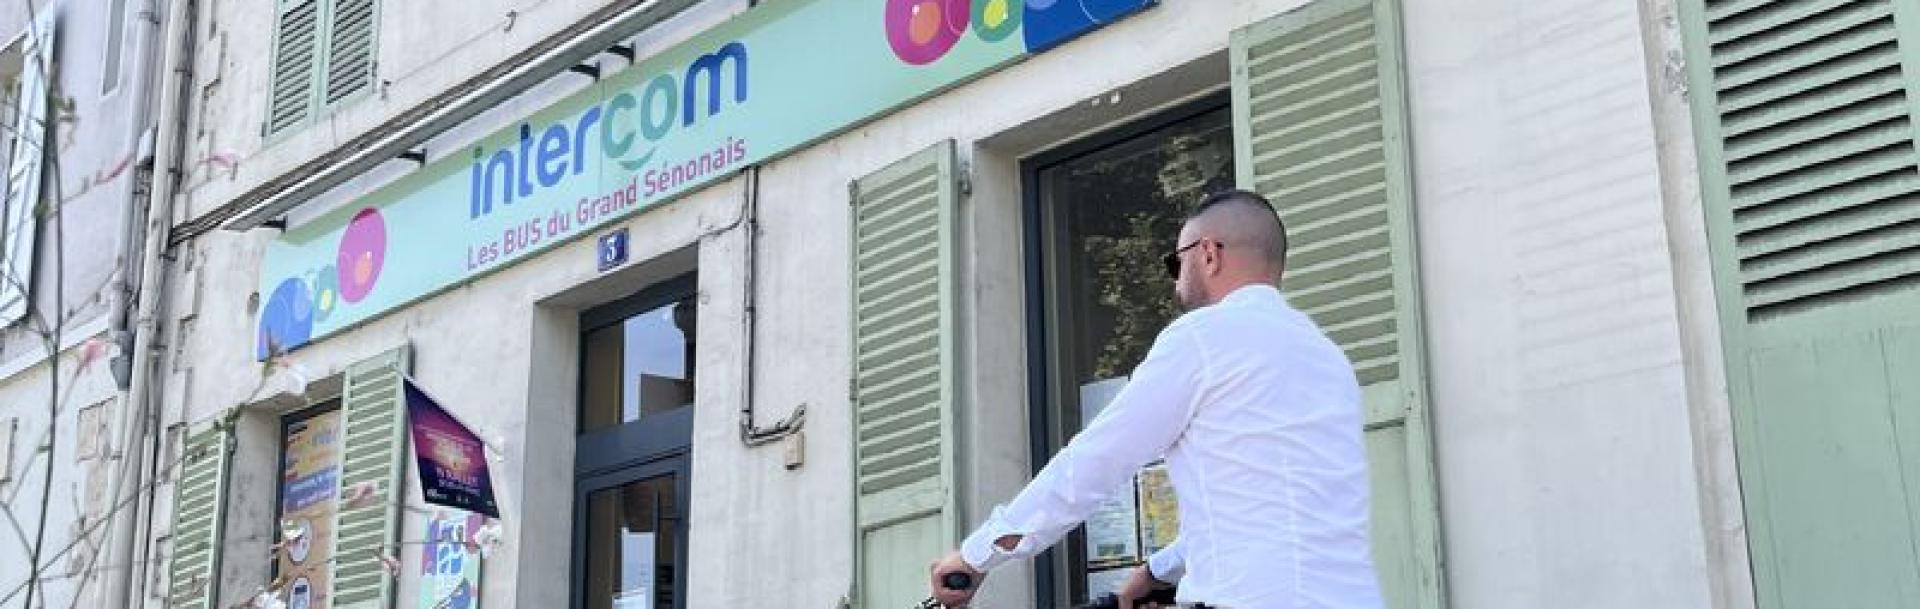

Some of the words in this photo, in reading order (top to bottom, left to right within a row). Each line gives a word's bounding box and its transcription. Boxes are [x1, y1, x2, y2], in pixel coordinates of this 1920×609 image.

[468, 242, 498, 271] Les
[503, 217, 541, 255] BUS
[547, 209, 570, 236] du
[576, 176, 638, 224] Grand
[644, 136, 746, 198] Sénonais
[470, 41, 747, 219] intercom
